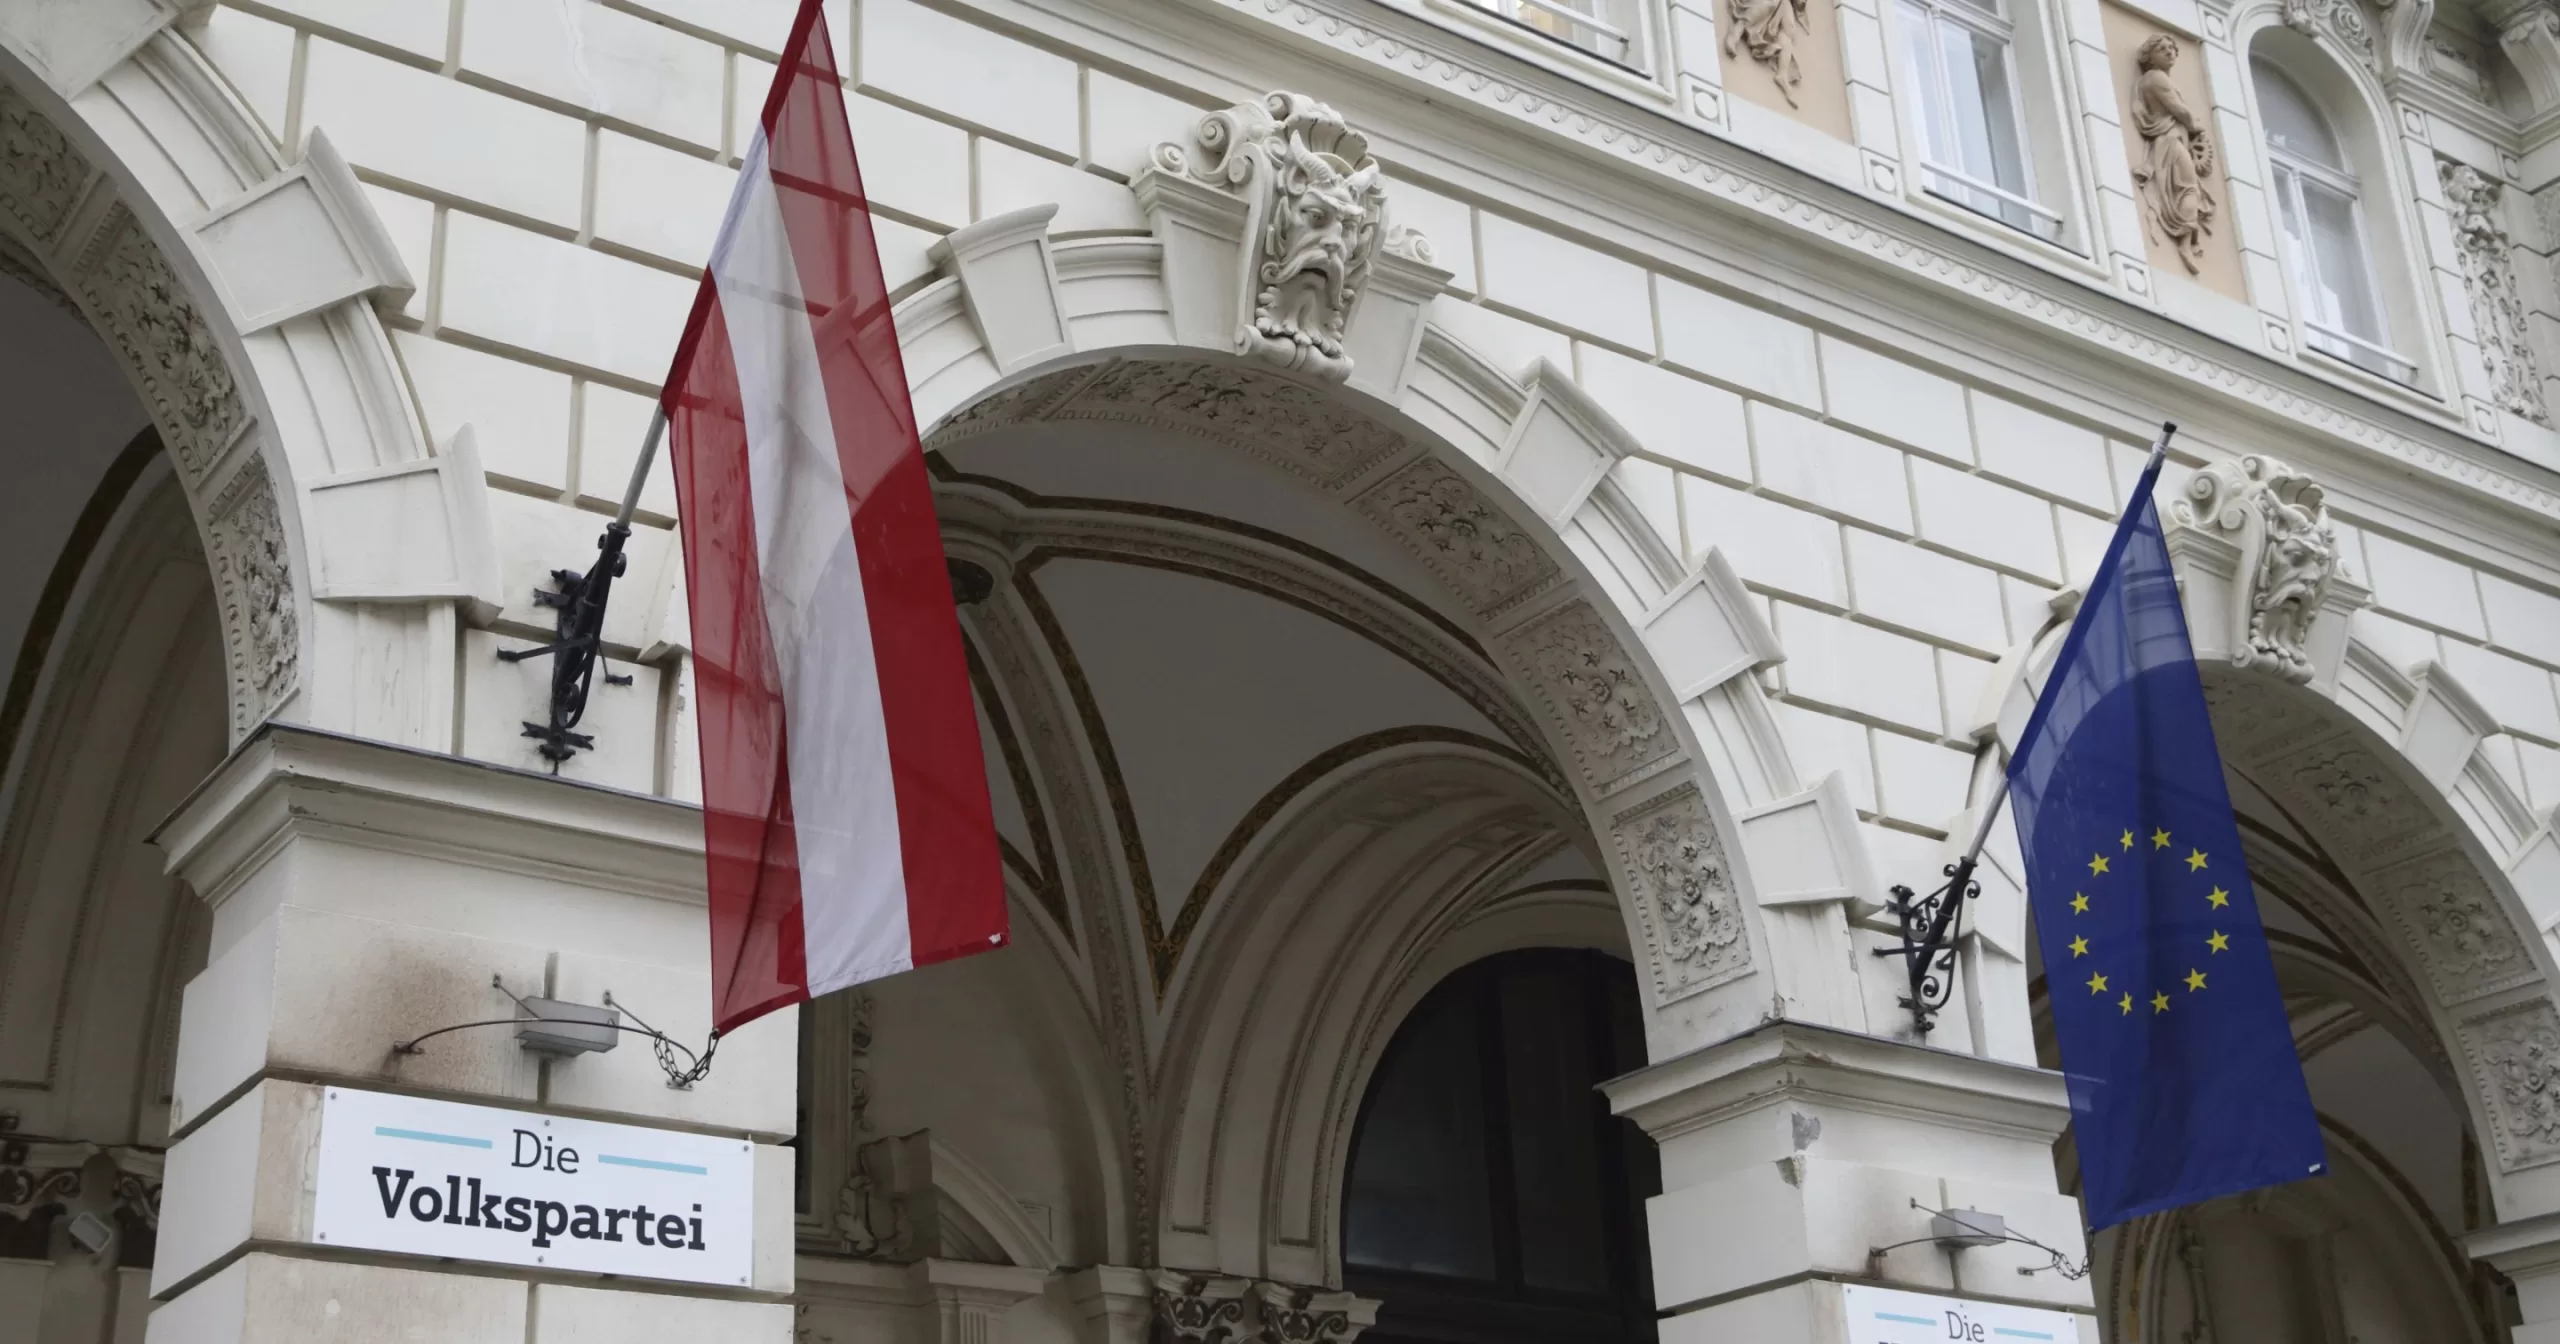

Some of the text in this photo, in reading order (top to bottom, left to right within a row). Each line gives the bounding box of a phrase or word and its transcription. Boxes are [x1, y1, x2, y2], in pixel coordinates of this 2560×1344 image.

[511, 1129, 580, 1174] Die
[371, 1166, 706, 1251] Volkspartei
[1945, 1310, 1985, 1343] Die
